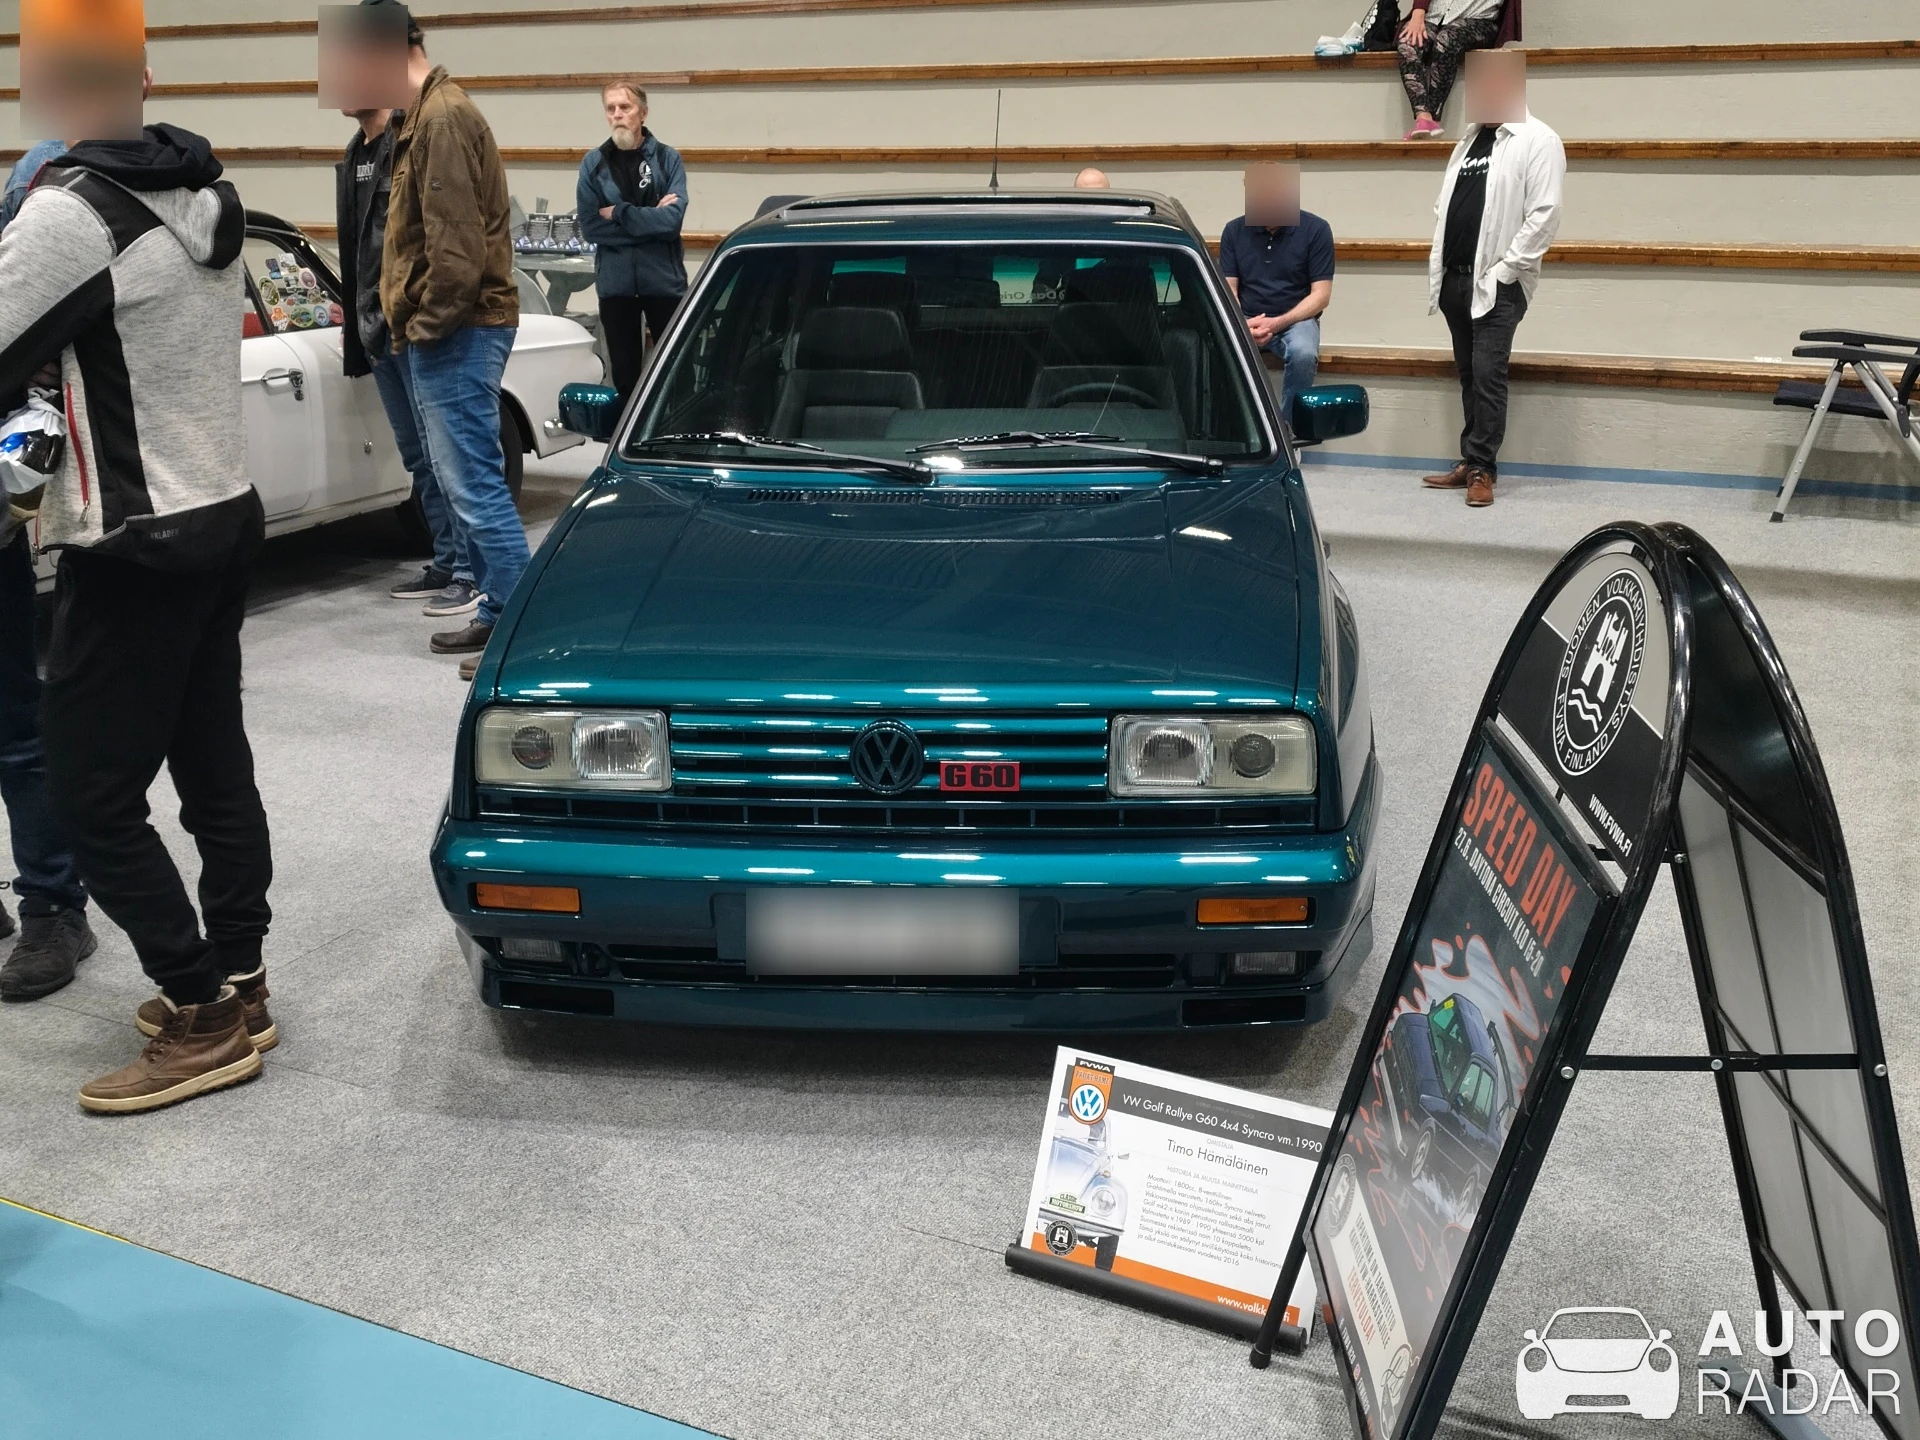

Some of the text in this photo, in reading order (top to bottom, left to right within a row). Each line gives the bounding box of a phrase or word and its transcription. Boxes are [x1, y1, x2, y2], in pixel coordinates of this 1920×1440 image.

[1562, 579, 1645, 729] SUOMEN VOLKKARIYHDISTYS
[1556, 694, 1608, 769] FVWA FINLAND
[1589, 794, 1632, 857] WWW.FVWA.FI
[1463, 763, 1576, 949] SPEED DAY
[1455, 827, 1545, 977] 27.6. DAYTONA CIRCUIT KLO 15-20
[1080, 1061, 1111, 1072] FVWA
[1123, 1094, 1141, 1107] VW
[1143, 1100, 1164, 1113] Golf
[1166, 1105, 1193, 1121] Rallye
[1196, 1113, 1218, 1127] G60
[1220, 1120, 1239, 1132] 4x4
[1242, 1125, 1274, 1141] Syncro
[1168, 1139, 1269, 1176] Timo Hämäläinen
[1207, 1138, 1234, 1150] OMISTAJA
[1144, 1199, 1156, 1207] Golf
[1224, 1203, 1243, 1214] Syncro
[1196, 1222, 1211, 1230] 1990
[1239, 1234, 1254, 1242] 5000
[1224, 1257, 1240, 1266] 2016
[1255, 1256, 1282, 1269] historians
